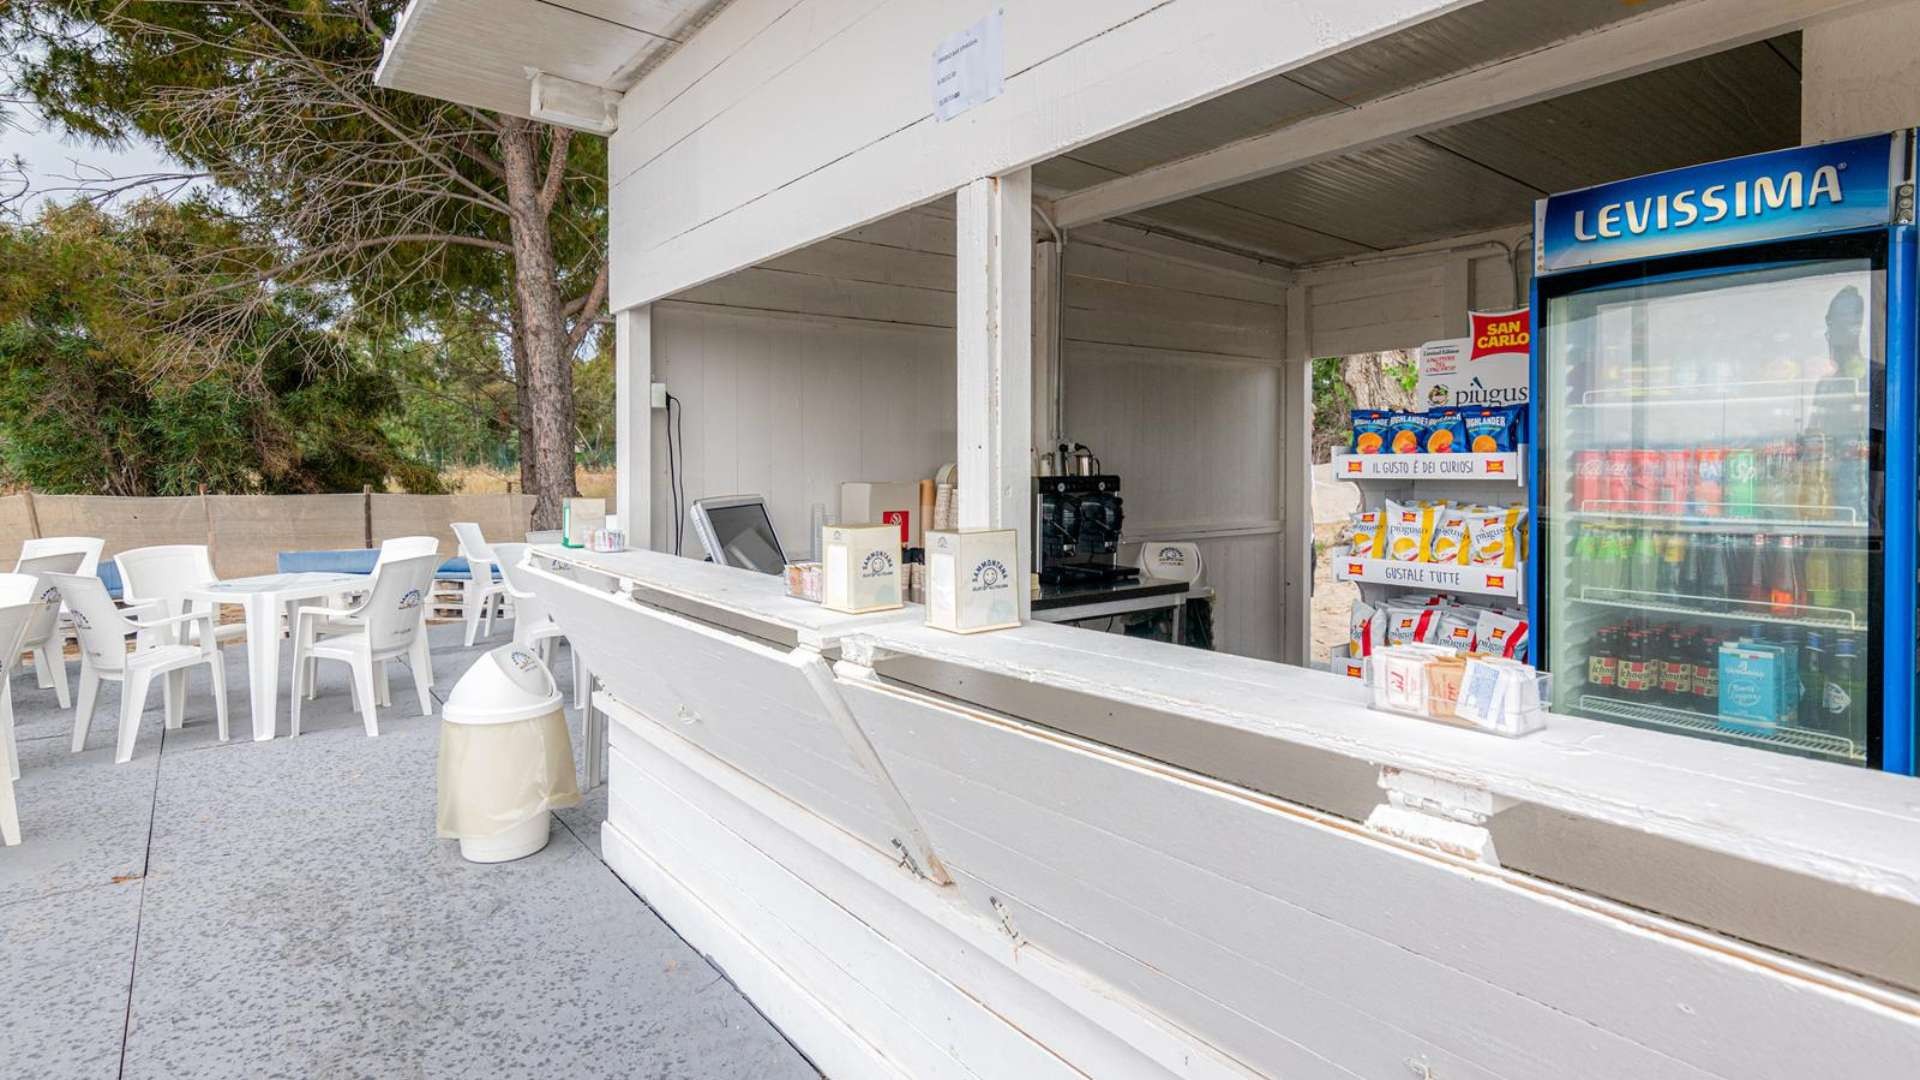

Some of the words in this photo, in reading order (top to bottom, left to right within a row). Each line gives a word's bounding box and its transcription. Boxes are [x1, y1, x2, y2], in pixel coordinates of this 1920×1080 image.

[1574, 164, 1843, 242] LEVISSIMA
[1486, 320, 1521, 336] SAN
[1477, 331, 1530, 349] CARLO
[1382, 461, 1409, 474] GUSTO
[1422, 461, 1436, 474] DEI
[1440, 460, 1474, 474] CURIOSI
[1385, 567, 1424, 582] GUSTALE
[1430, 571, 1461, 585] TUTTE
